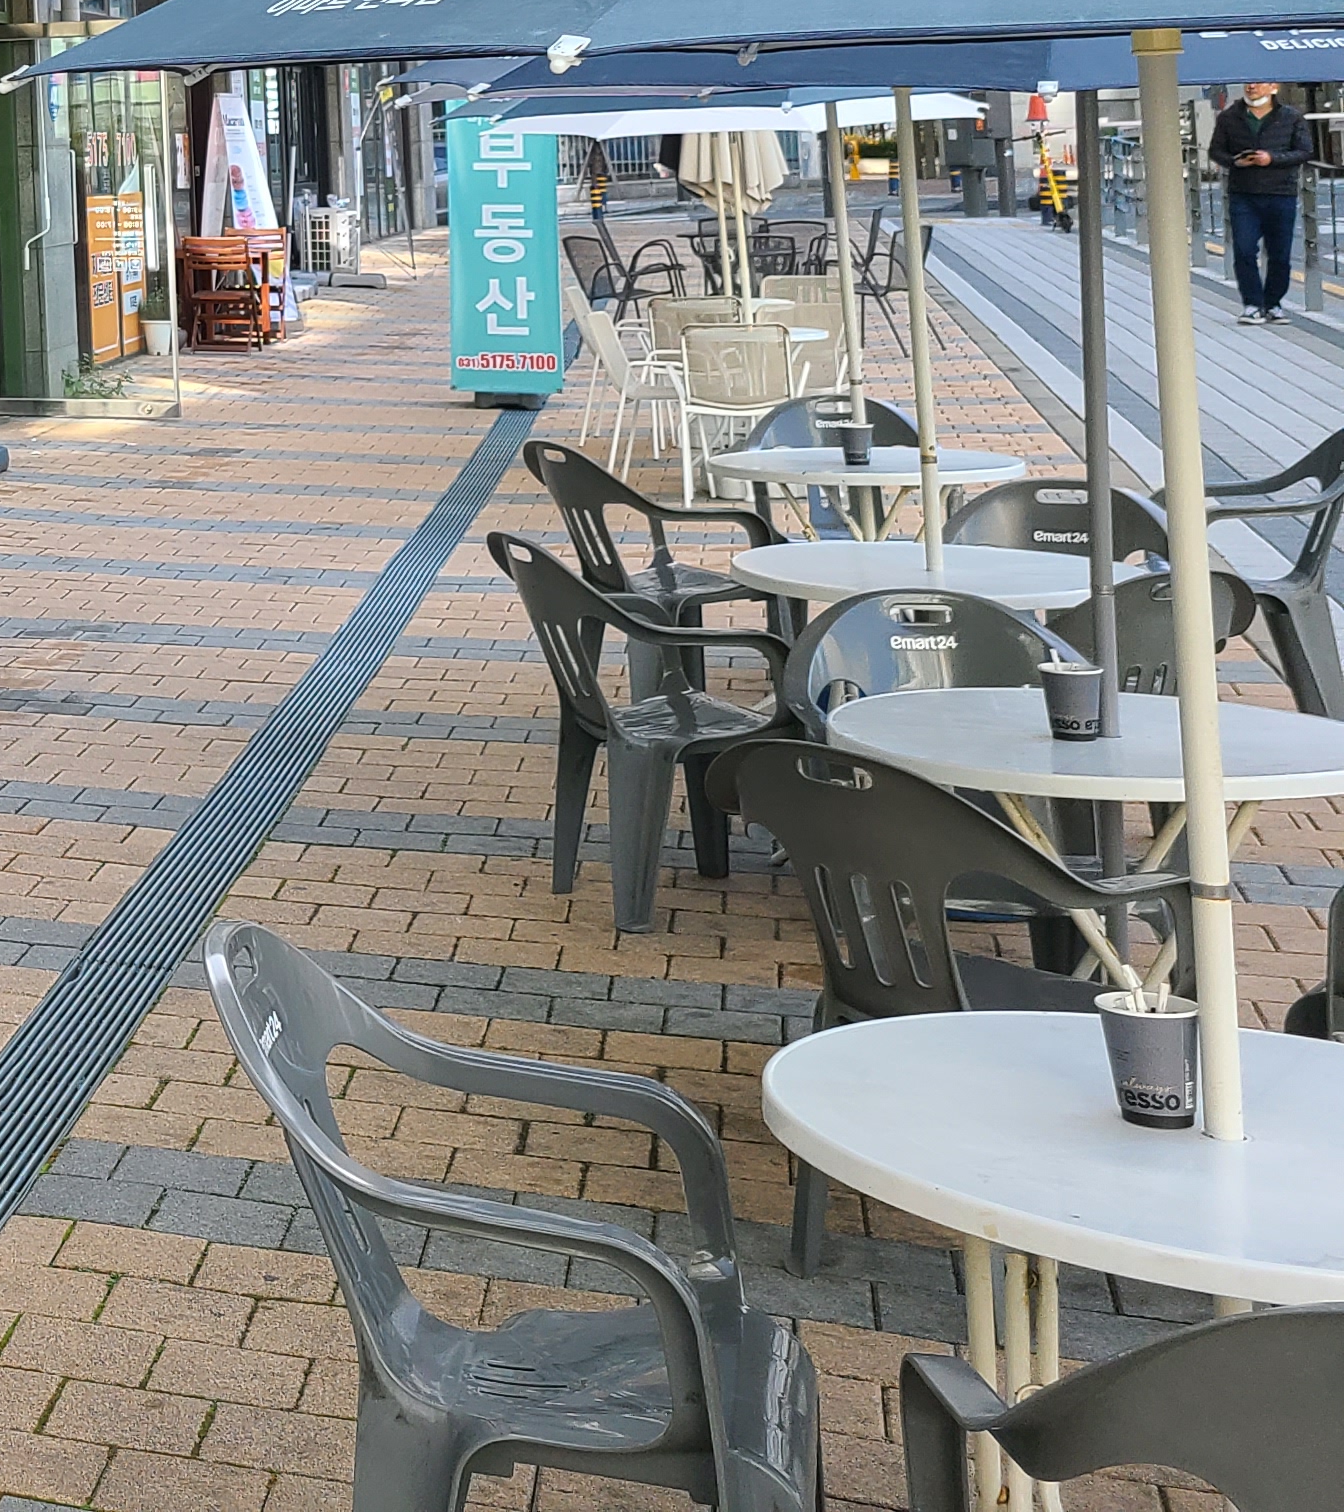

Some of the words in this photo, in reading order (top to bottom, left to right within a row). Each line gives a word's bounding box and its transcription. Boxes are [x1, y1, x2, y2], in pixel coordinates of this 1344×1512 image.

[472, 133, 534, 337] 부동산
[1033, 530, 1089, 544] emart24
[890, 635, 959, 650] emart24
[1120, 1089, 1181, 1111] esso
